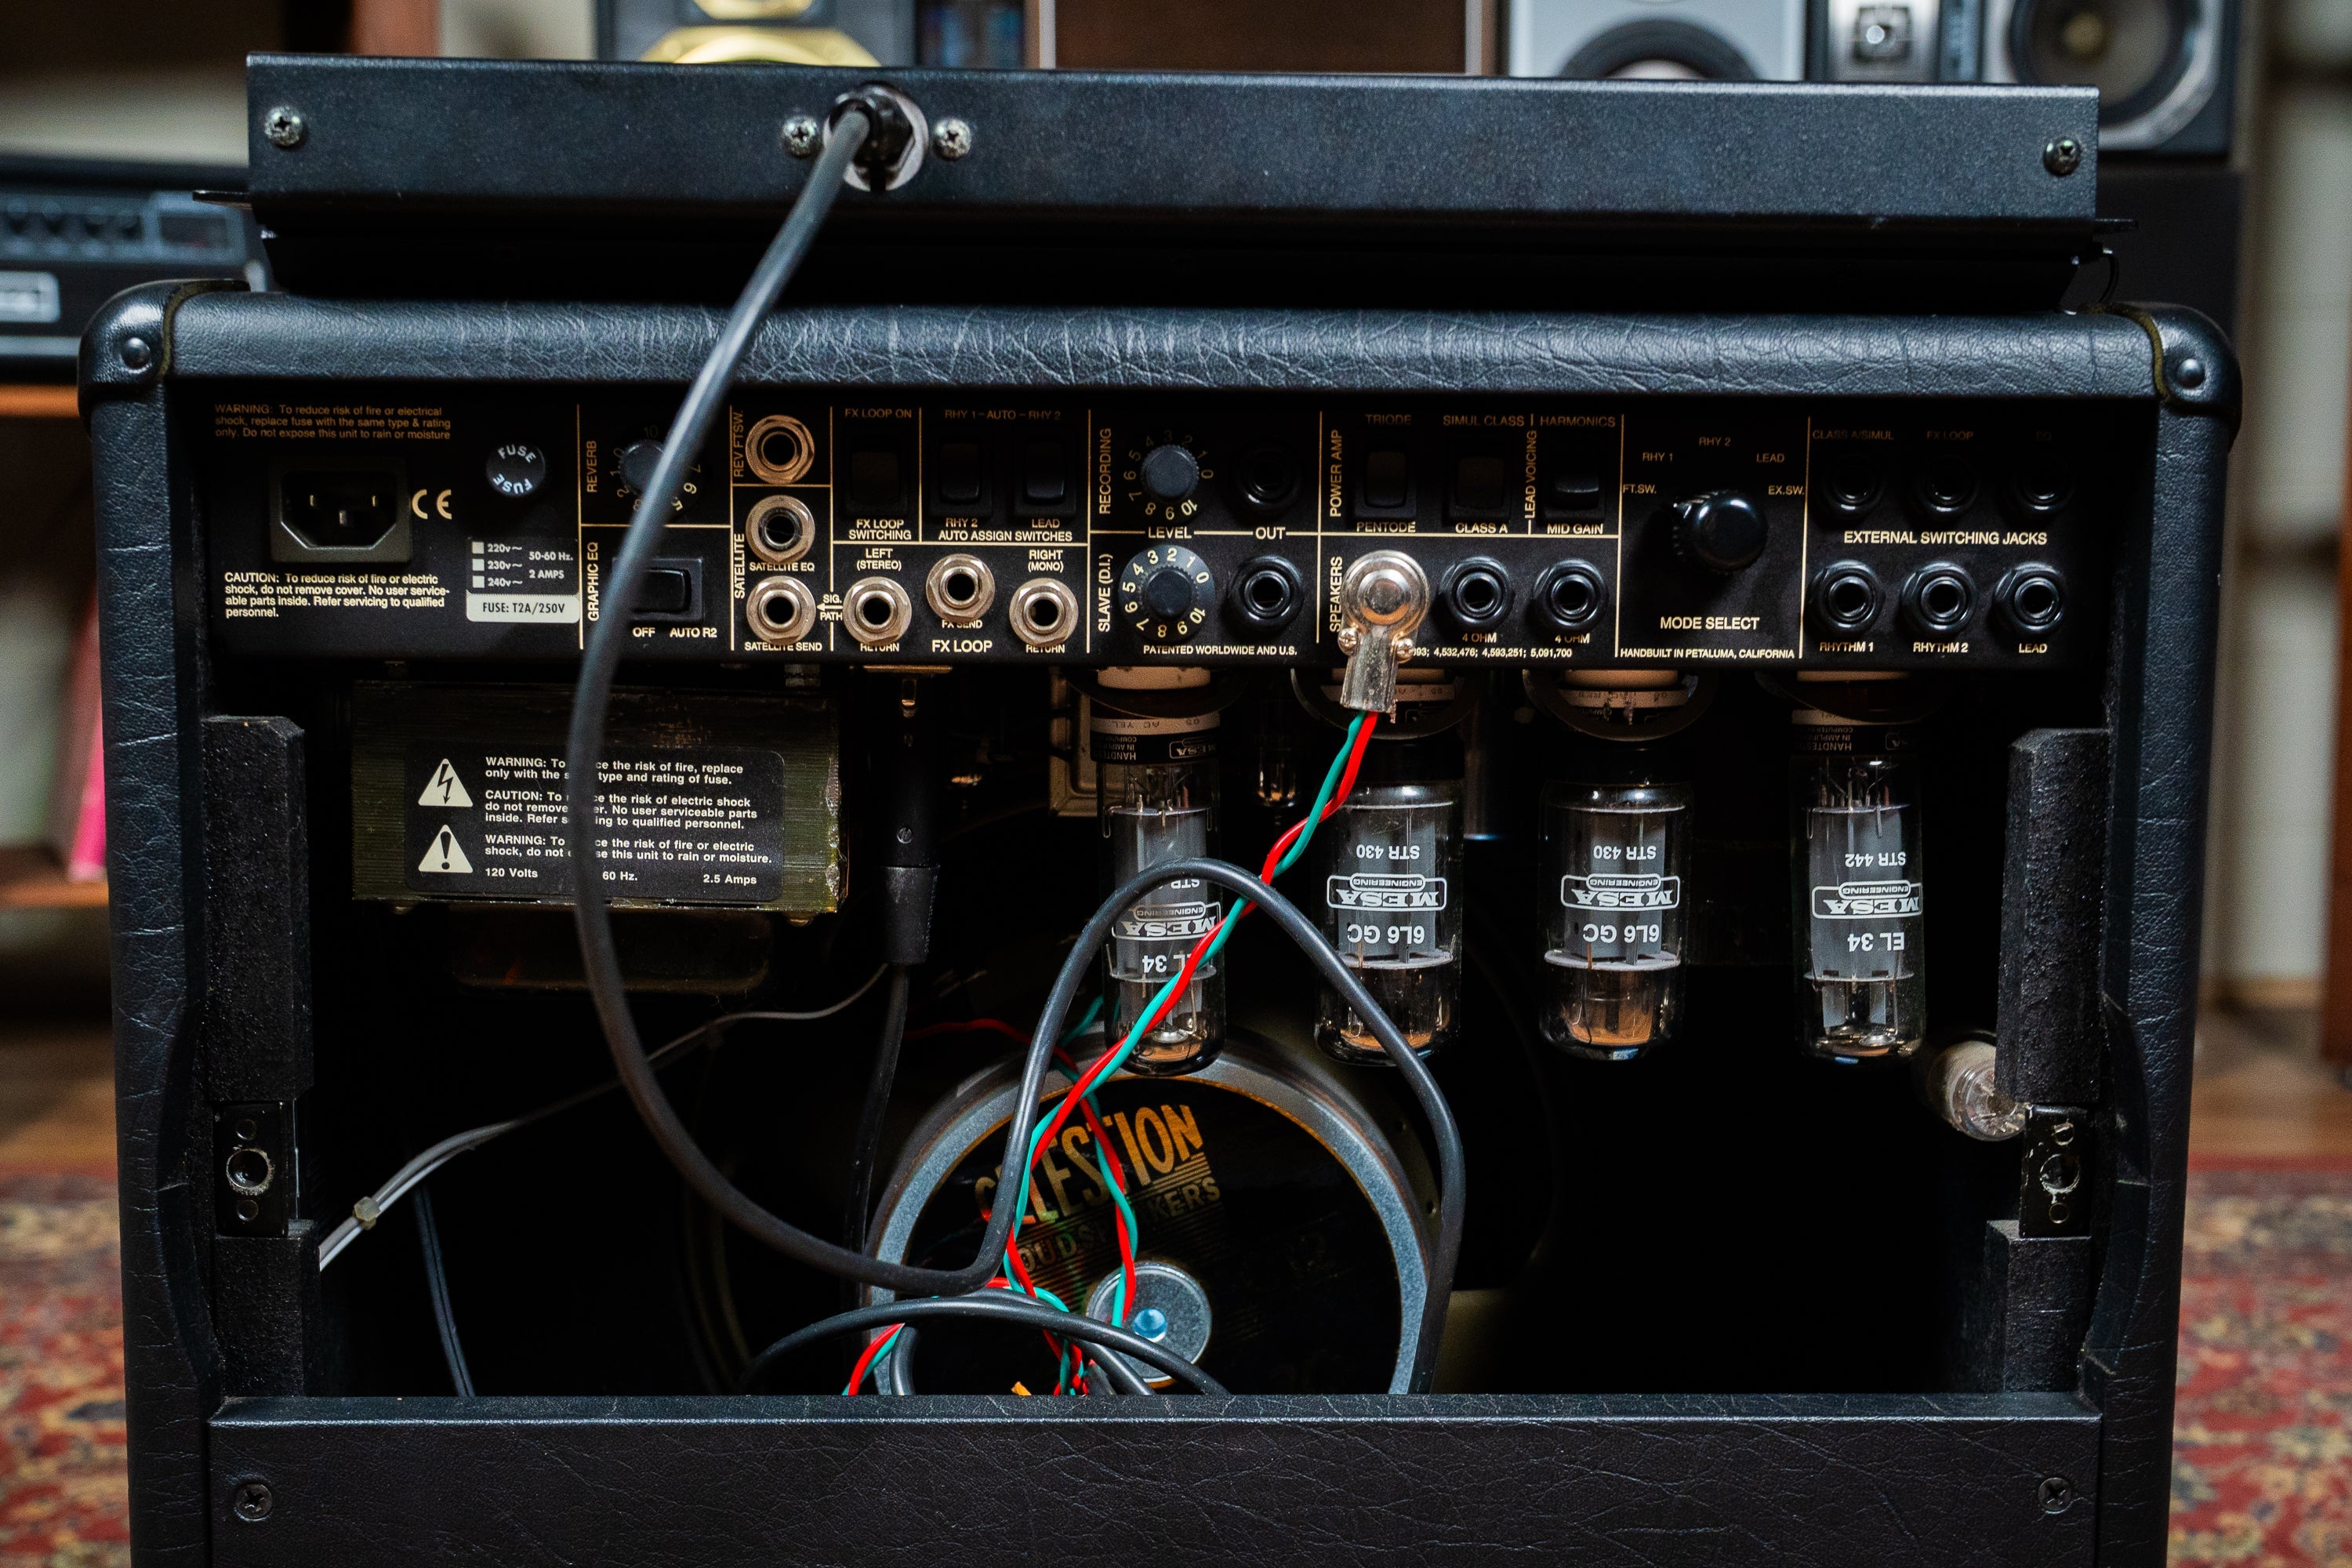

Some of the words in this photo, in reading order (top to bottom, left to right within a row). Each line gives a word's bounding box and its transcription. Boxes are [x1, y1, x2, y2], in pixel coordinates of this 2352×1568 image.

[862, 408, 892, 417] LOOP
[895, 409, 911, 418] ON
[1366, 414, 1410, 423] TRIODE
[1443, 416, 1479, 425] SIMUL
[1484, 416, 1524, 426] CLASS
[1541, 416, 1615, 426] HARMONICS
[732, 410, 743, 448] FTSW.
[1331, 430, 1341, 459] AMP
[1700, 437, 1721, 445] RHY
[1725, 437, 1730, 446] 2
[499, 445, 535, 463] FUSE
[1526, 430, 1537, 482] VOICING
[1643, 452, 1664, 461] RHY
[1757, 453, 1784, 463] LEAD
[586, 441, 597, 492] REVERB
[732, 452, 744, 477] REV
[1099, 429, 1111, 514] RECORDING
[493, 473, 532, 494] FUSE
[1621, 483, 1656, 495] FT.SW.
[1330, 465, 1341, 517] POWER
[1769, 486, 1804, 495] EX.SW.
[1525, 486, 1535, 518] LEAD
[857, 520, 870, 528] FX
[874, 520, 904, 528] LOOP
[946, 518, 967, 527] RHY
[971, 519, 978, 528] 2
[1357, 521, 1415, 532] PENTODE
[1456, 524, 1496, 533] CLASS
[1499, 524, 1508, 533] A
[1548, 524, 1570, 534] MID
[1573, 524, 1603, 534] GAIN
[849, 530, 911, 539] SWITCHING
[938, 531, 968, 540] AUTO
[971, 531, 1011, 541] ASSIGN
[1015, 531, 1073, 542] SWITCHES
[1149, 527, 1192, 539] LEVEL
[1256, 527, 1285, 539] OUT
[1845, 531, 1917, 543] EXTERNAL
[1921, 532, 1999, 544] SWITCHING
[2002, 532, 2047, 545] JACKS
[529, 551, 556, 561] 50-60
[558, 552, 573, 561] Hz.
[587, 543, 597, 560] EQ
[866, 548, 893, 558] LEFT
[1029, 550, 1063, 560] RIGHT
[734, 534, 745, 598] SATELLITE
[749, 562, 798, 572] SATELLITE
[800, 562, 815, 572] EQ
[857, 560, 902, 571] (STEREO)
[1028, 561, 1063, 573] (MONO)
[1099, 554, 1113, 584] (D.I.)
[225, 572, 279, 583] CAUTION:
[286, 574, 298, 583] To
[301, 575, 335, 583] reduce
[339, 575, 356, 583] risk
[358, 575, 368, 583] of
[371, 575, 387, 584] fire
[402, 574, 437, 584] electric
[529, 569, 535, 578] 2
[538, 570, 564, 579] AMPS
[226, 584, 258, 595] shock,
[261, 584, 274, 593] do
[277, 585, 292, 594] not
[296, 586, 332, 597] remove
[336, 586, 365, 595] cover.
[368, 585, 383, 595] No
[410, 586, 449, 596] service-
[587, 564, 599, 621] GRAPHIC
[1330, 556, 1342, 633] SPEAKERS
[226, 596, 247, 605] able
[250, 597, 275, 607] parts
[278, 596, 310, 605] inside.
[314, 596, 341, 606] Refer
[343, 597, 387, 608] servicing
[390, 597, 400, 607] to
[402, 597, 445, 608] qualified
[822, 594, 842, 604] SIG.
[226, 608, 278, 619] personnel.
[483, 603, 509, 612] FUSE:
[513, 603, 564, 615] T2A/250V
[1098, 587, 1110, 632] SLAVE
[819, 612, 843, 621] PATH
[1661, 617, 1701, 629] MODE
[1705, 617, 1759, 630] SELECT
[633, 627, 655, 637] OFF
[670, 628, 700, 637] AUTO
[702, 627, 717, 637] R2
[1462, 633, 1468, 643] 4
[1471, 633, 1497, 644] OHM
[745, 641, 793, 652] SATELLITE
[796, 641, 822, 652] SEND
[932, 640, 949, 652] FX
[954, 640, 993, 652] LOOP
[1144, 645, 1193, 654] PATENTED
[1196, 645, 1254, 655] WORLDWIDE
[1257, 646, 1276, 655] AND
[1279, 646, 1297, 655] U.S.
[1819, 641, 1866, 652] RHYTHM
[1868, 641, 1874, 652] 1
[1913, 641, 1960, 653] RHYTHM
[1961, 641, 1969, 653] 2
[2019, 644, 2047, 653] LEAD
[1621, 648, 1671, 657] HANDBUILT
[1674, 649, 1683, 658] IN
[1686, 649, 1737, 659] PETALUMA,
[1739, 649, 1795, 659] CALIFORNIA
[486, 757, 546, 767] WARNING:
[551, 759, 565, 768] To
[613, 760, 630, 770] the
[636, 761, 655, 771] risk
[660, 762, 671, 771] of
[676, 763, 697, 773] fire,
[702, 764, 743, 775] replace
[617, 817, 628, 826] to
[633, 818, 681, 828] qualified
[685, 818, 744, 829] personnel.
[1356, 844, 1384, 859] 430
[1388, 844, 1420, 859] STR
[1594, 845, 1621, 859] 430
[1627, 846, 1656, 860] STR
[1846, 853, 1874, 867] 442
[1878, 852, 1905, 866] STR
[486, 868, 505, 877] 120
[510, 868, 538, 877] Volts
[603, 871, 615, 880] 60
[620, 871, 637, 880] Hz.
[703, 874, 720, 883] 2.5
[725, 874, 757, 886] Amps
[1353, 878, 1423, 887] ENGINEERING
[1589, 878, 1658, 887] ENGINEERING
[1841, 885, 1909, 894] ENGINEERING
[1335, 888, 1439, 907] MESA
[1570, 888, 1673, 907] MESA
[1137, 906, 1203, 916] ENGINEERING
[1823, 896, 1919, 915] MESA
[1121, 916, 1216, 937] MESA
[1348, 924, 1380, 944] GC
[1388, 926, 1425, 944] 6L6
[1583, 924, 1617, 943] GC
[1624, 924, 1661, 944] 6L6
[1848, 933, 1873, 952] 34
[1878, 932, 1904, 953] EL
[1142, 955, 1167, 973] 34
[975, 1104, 1203, 1225] CLESION
